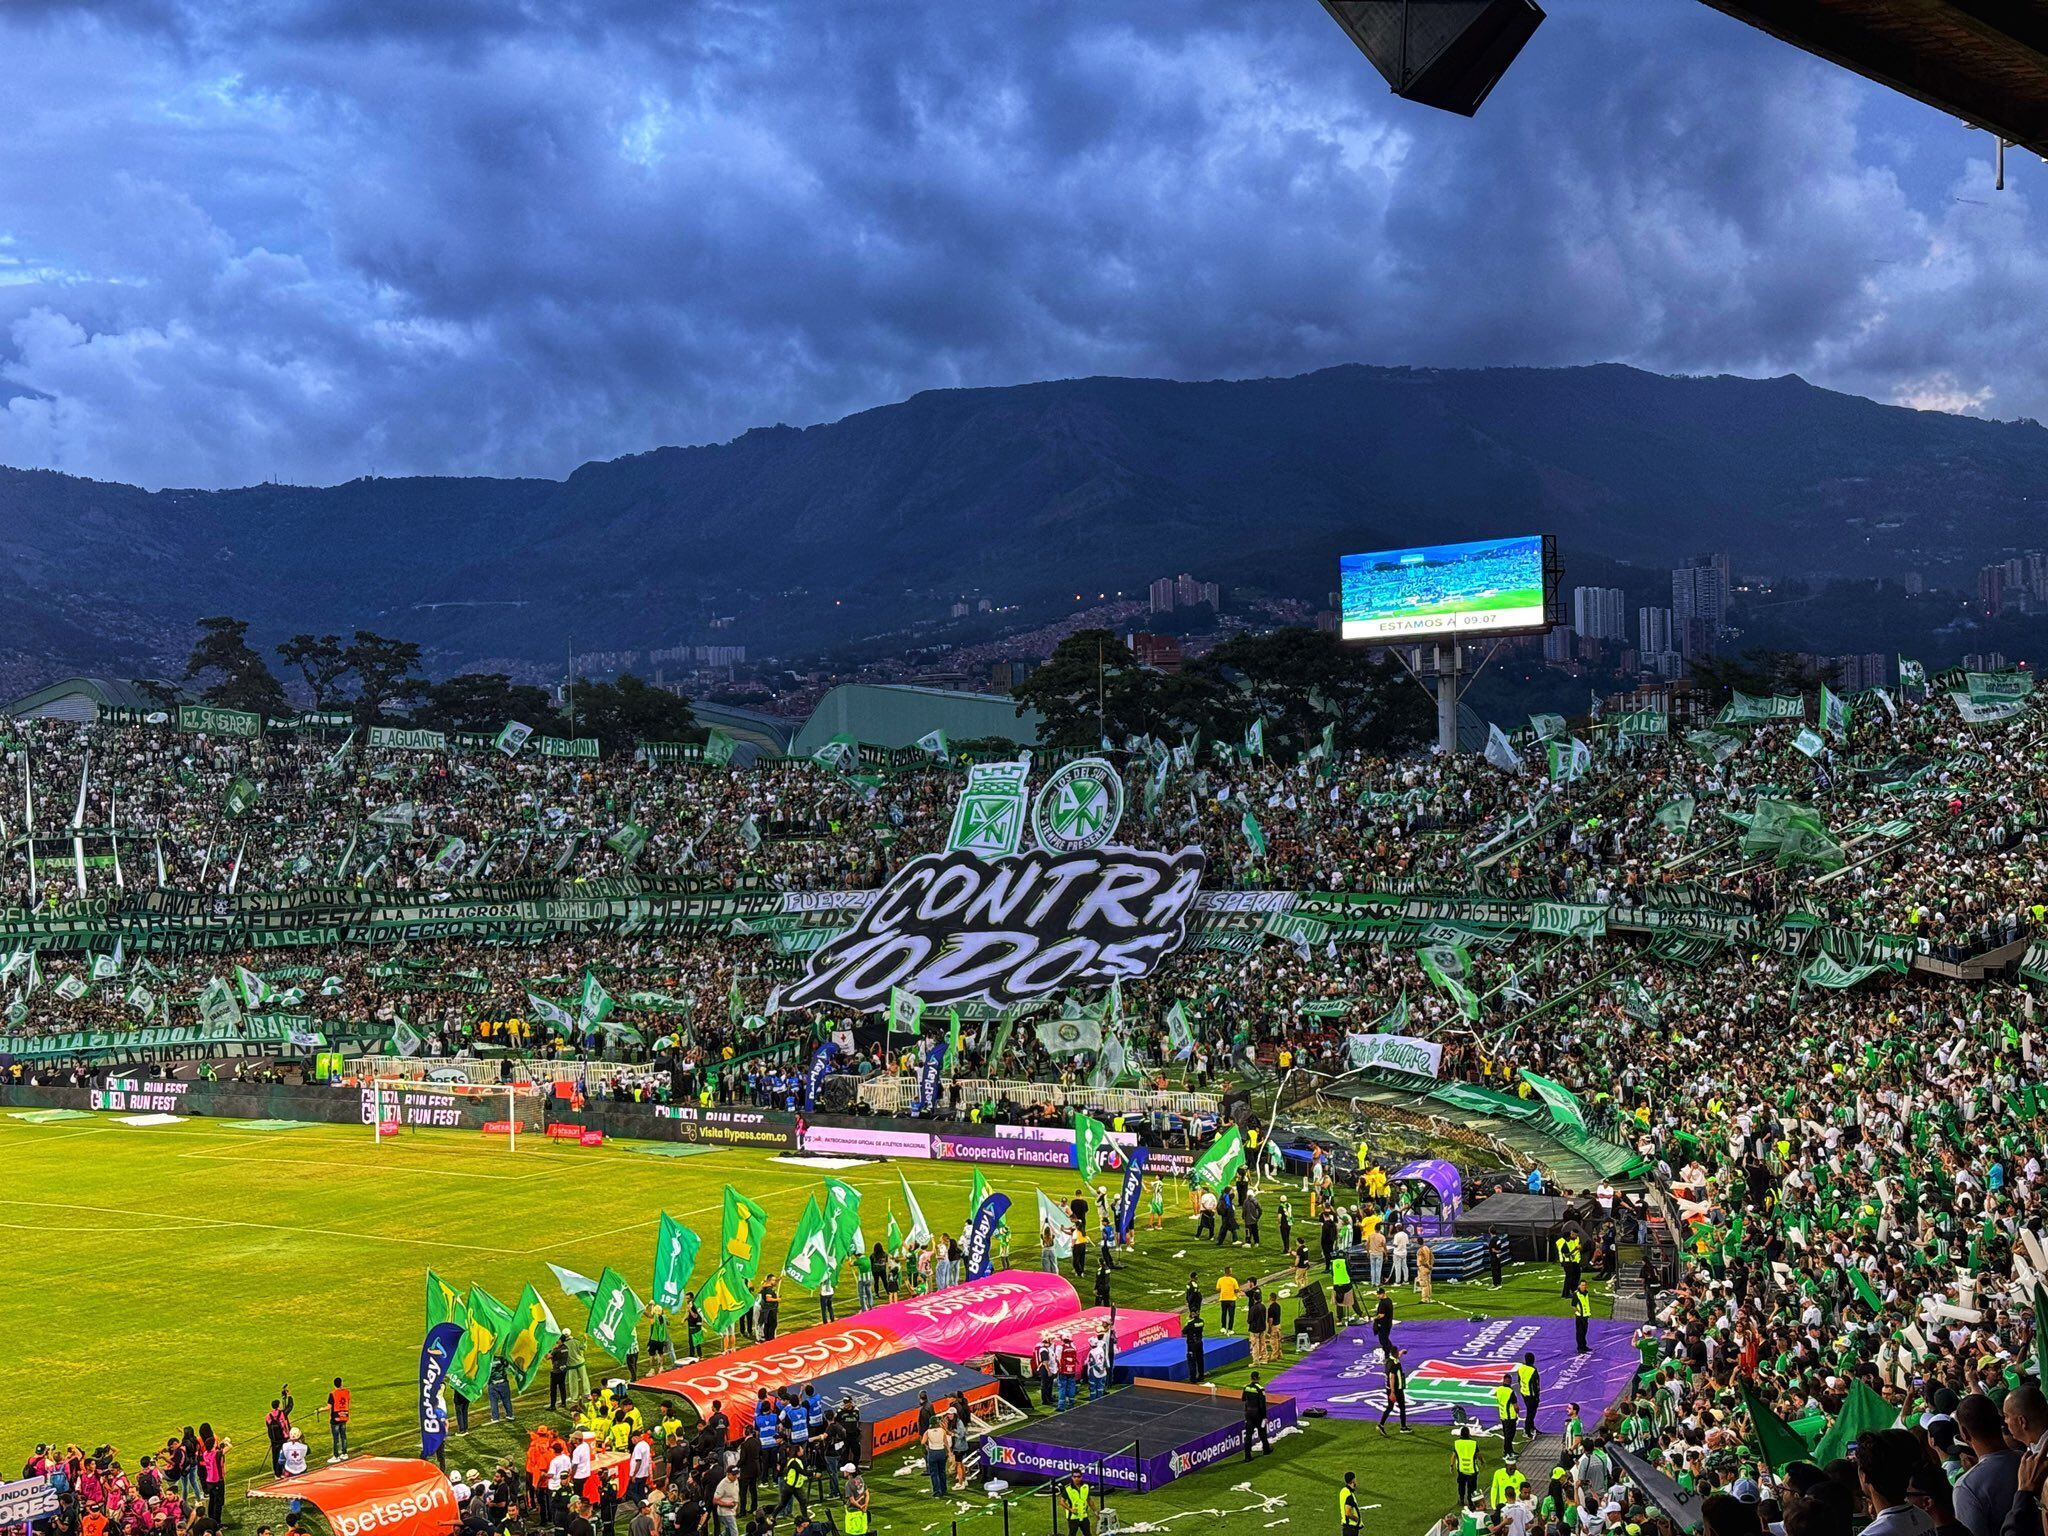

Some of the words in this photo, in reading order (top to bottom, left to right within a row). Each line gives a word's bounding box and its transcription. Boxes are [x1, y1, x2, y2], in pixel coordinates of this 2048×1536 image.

[1379, 618, 1442, 632] ESTAMOS
[183, 711, 199, 729] EL
[372, 730, 384, 747] EL
[388, 730, 444, 749] AGUANTE
[543, 737, 597, 756] FREDONIA
[1054, 773, 1072, 791] LOS
[1073, 767, 1090, 779] DEL
[1091, 768, 1107, 783] SUR
[1041, 819, 1065, 850] SIEMPRE
[1067, 812, 1113, 851] PRESENTES
[640, 875, 721, 895] DUENDES
[251, 887, 348, 911] SALVADOR
[731, 893, 782, 916] 1989
[787, 891, 877, 910] FUERZA
[868, 860, 1200, 932] CONTRA
[248, 907, 372, 931] FLORESTA
[383, 909, 404, 921] LA
[418, 904, 519, 919] MILAGROSA
[523, 902, 541, 919] EL
[546, 901, 600, 919] CARMELO
[801, 908, 857, 927] LOS
[106, 913, 246, 933] BARBOSA
[354, 921, 463, 941] RIONEGRO
[39, 934, 112, 951] JULIO
[252, 932, 278, 947] LA
[284, 928, 338, 945] CEJA
[789, 931, 1177, 1001] TODOS
[965, 1003, 987, 1017] DE
[0, 1032, 84, 1054] BOGOTA
[130, 1094, 150, 1110] RUN
[152, 1095, 177, 1111] FEST
[434, 1110, 462, 1126] FEST
[700, 1126, 723, 1138] Visita
[724, 1127, 787, 1142] flypass.com.co
[956, 1143, 1015, 1161] Cooperativa
[1017, 1149, 1070, 1164] Financiera
[1148, 1153, 1194, 1164] LUBRICANTES
[674, 1329, 884, 1397] betsson
[865, 1363, 945, 1392] ATANASIO
[879, 1368, 958, 1397] GIRARDOT
[873, 1421, 918, 1449] LCALDÍA
[1191, 1432, 1241, 1466] Cooperativa
[336, 1487, 449, 1536] betsson
